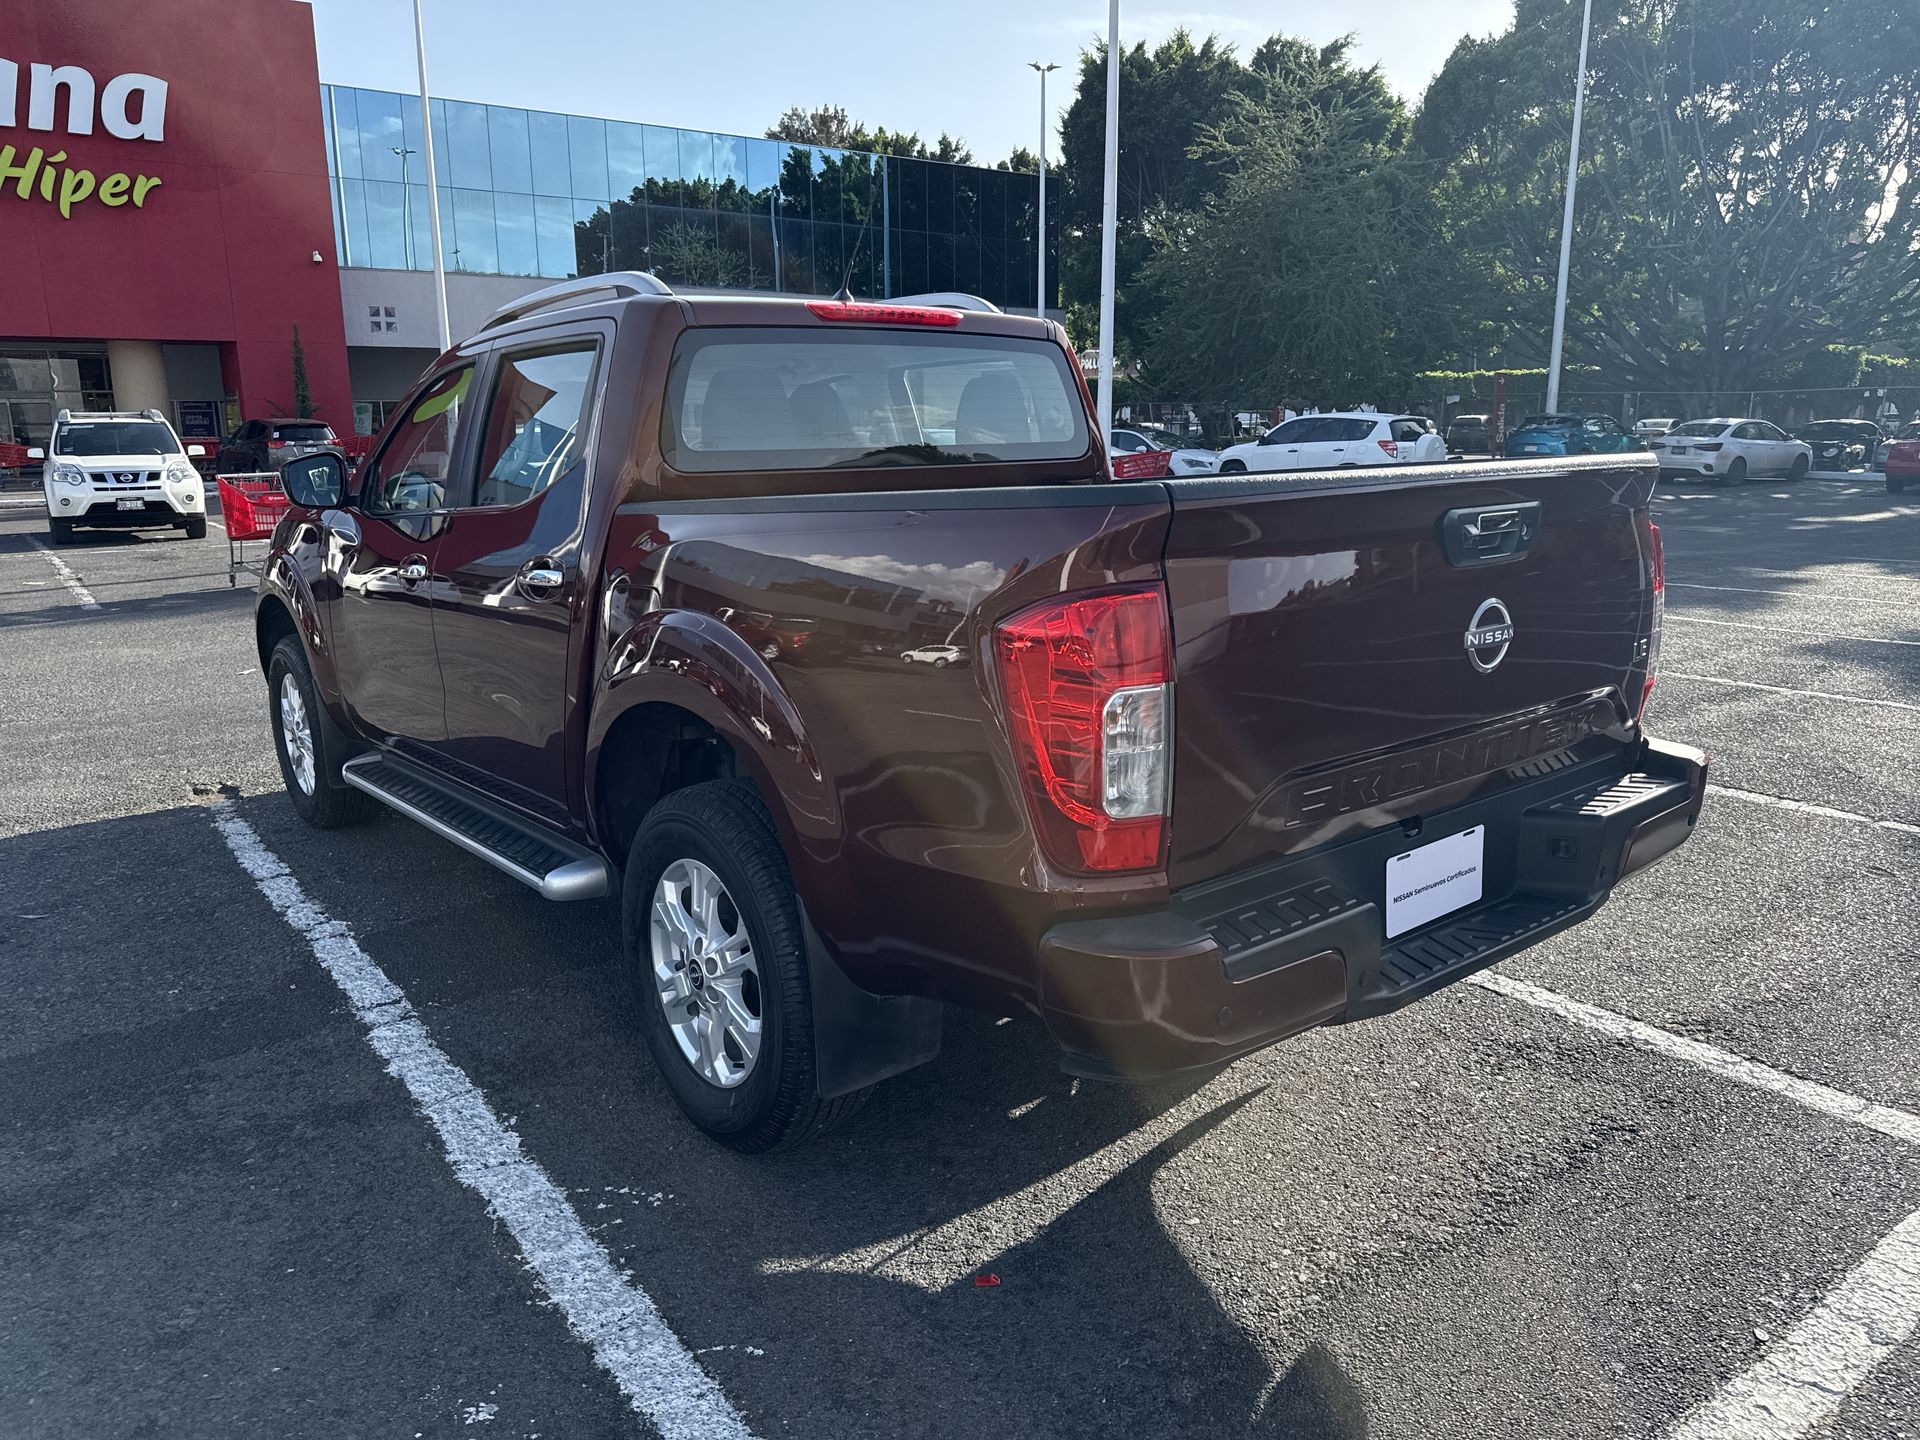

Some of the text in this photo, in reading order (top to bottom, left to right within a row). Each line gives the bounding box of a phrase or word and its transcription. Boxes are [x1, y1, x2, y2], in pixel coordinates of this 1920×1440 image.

[0, 57, 168, 141] na
[0, 144, 162, 219] Híper
[1467, 628, 1514, 646] NISSAN
[1633, 639, 1647, 662] LE
[1284, 706, 1596, 827] FRONTIER
[1393, 866, 1477, 904] NISSAN Seminuevos Certificados
